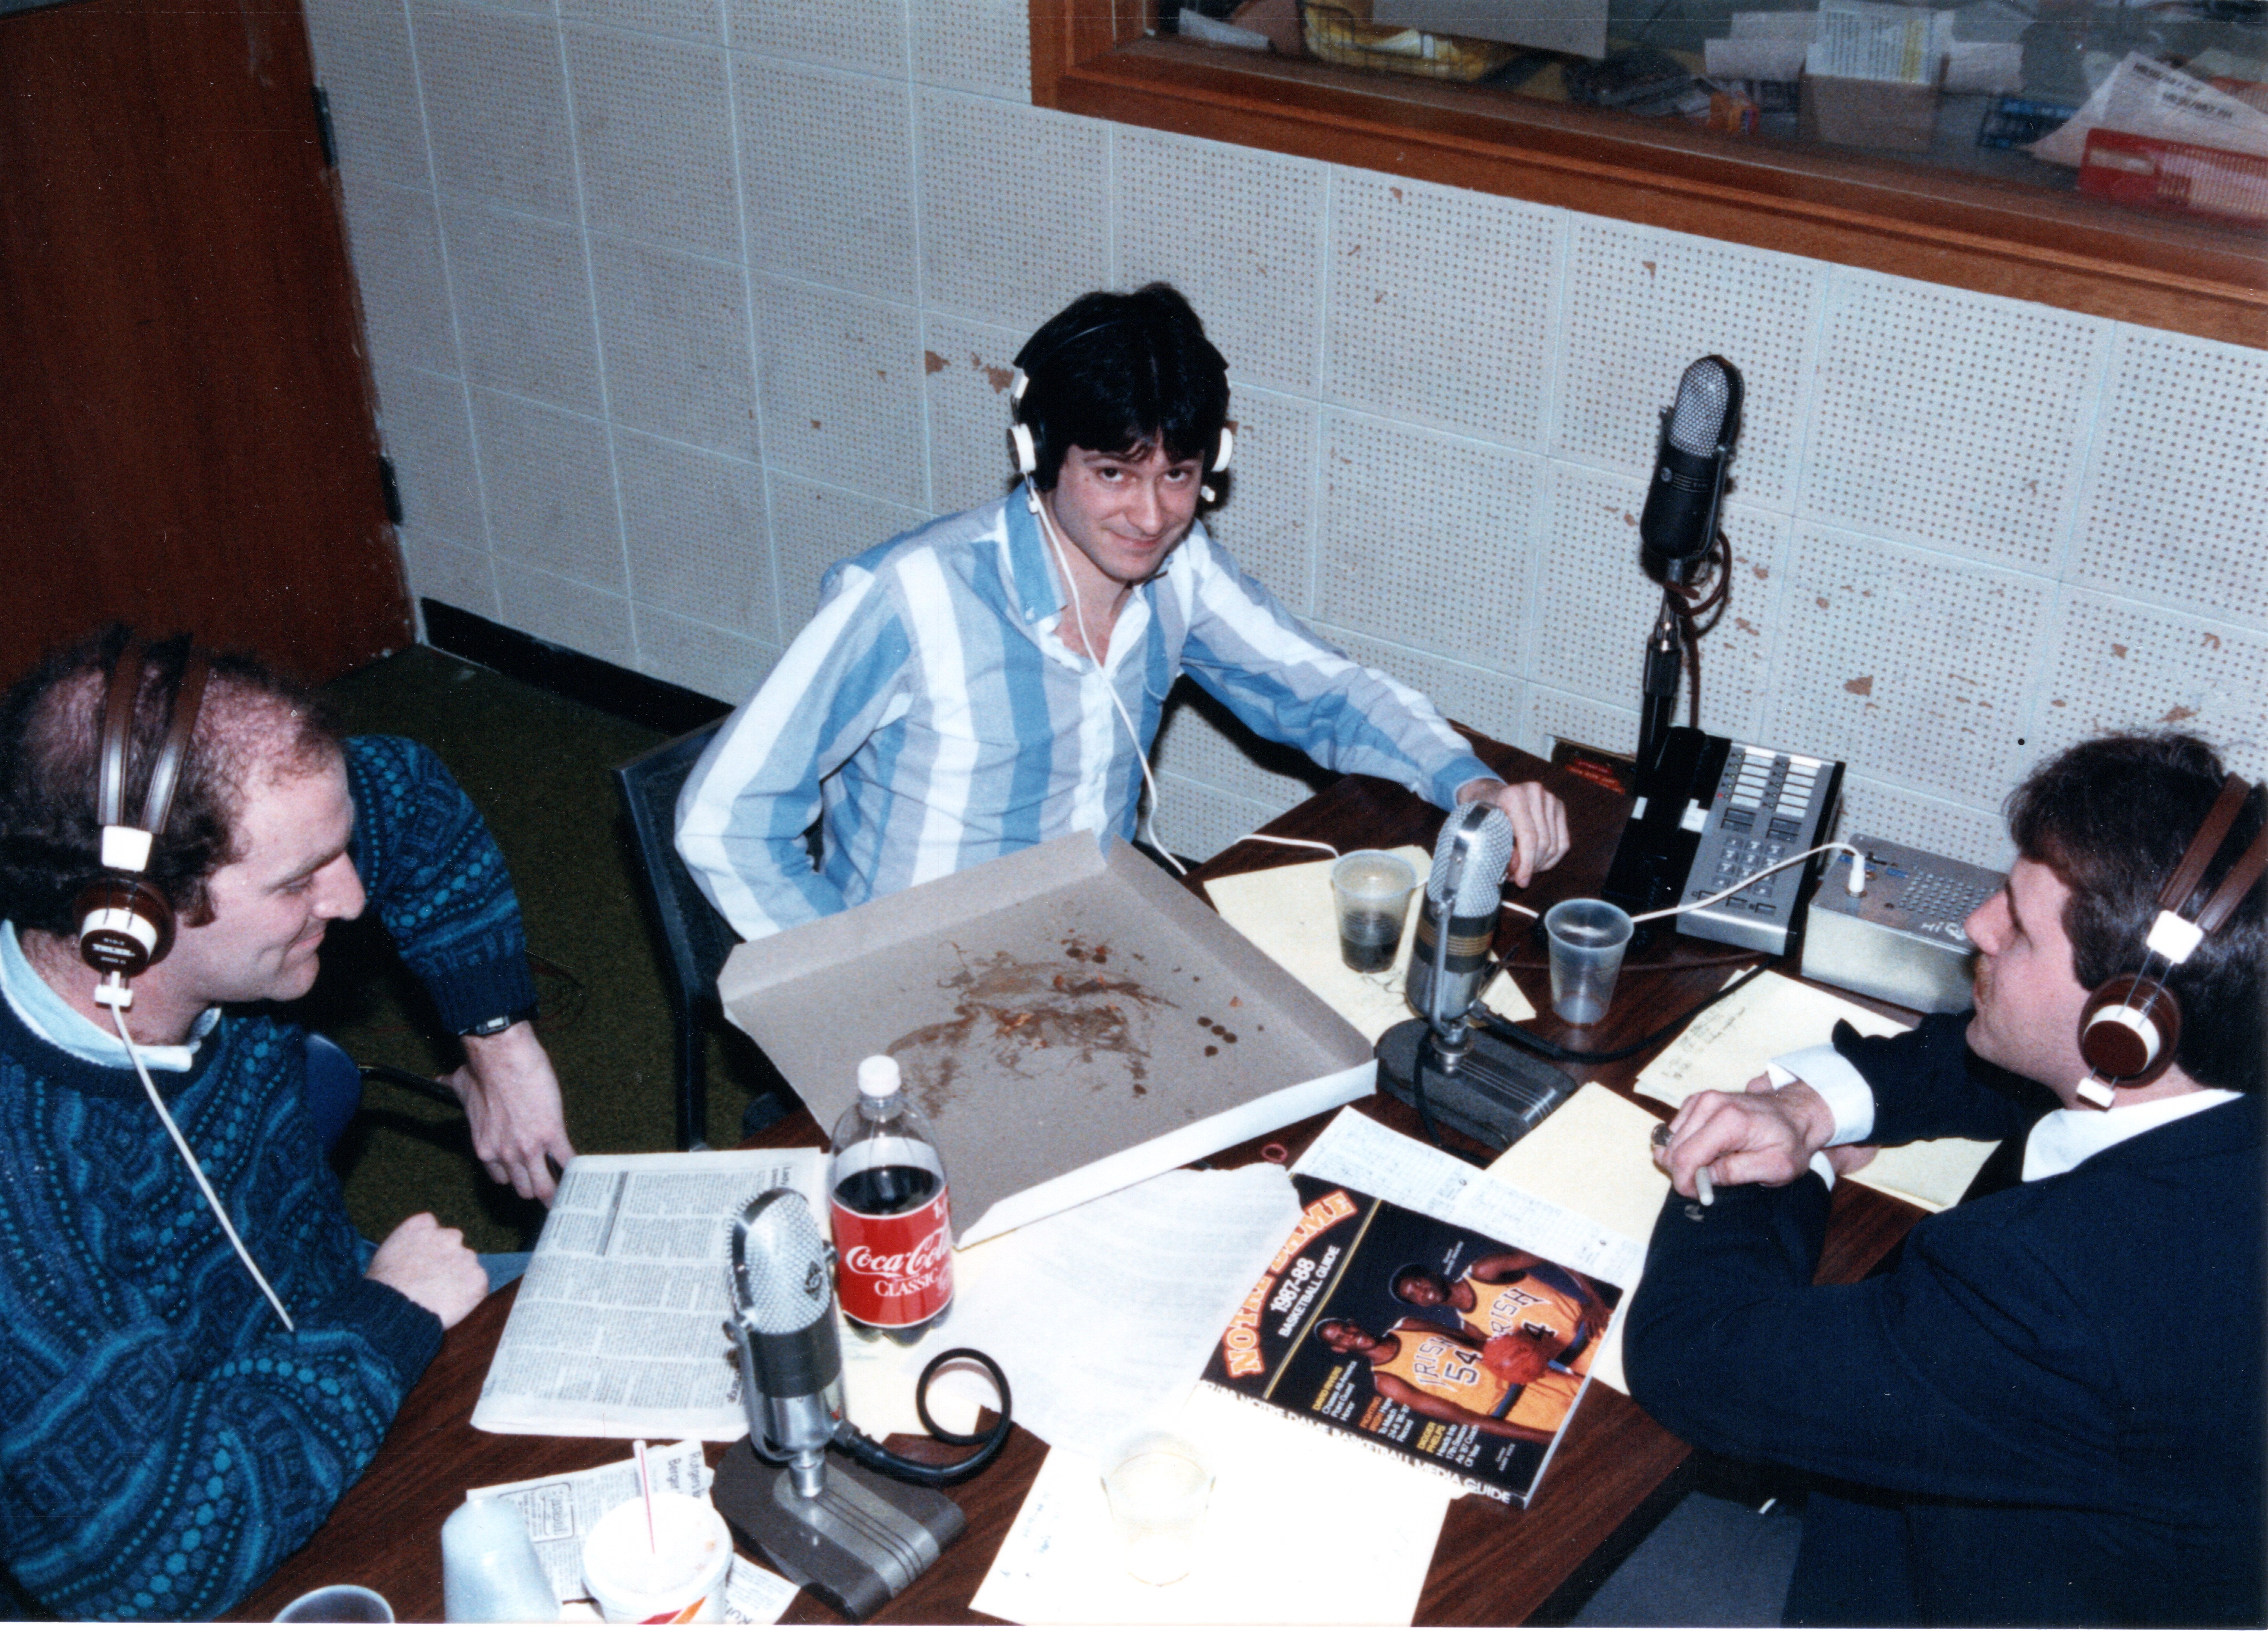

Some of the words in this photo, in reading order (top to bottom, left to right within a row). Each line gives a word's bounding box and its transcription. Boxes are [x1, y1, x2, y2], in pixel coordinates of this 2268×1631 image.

[874, 1267, 938, 1297] CLASSIC
[1270, 1257, 1316, 1312] 1987-88
[1278, 1280, 1323, 1337] BASKETBALL
[1315, 1244, 1341, 1279] GUIDE
[1488, 1287, 1552, 1338] RISH
[1414, 1336, 1459, 1392] IRISH
[1444, 1349, 1484, 1384] 54
[1312, 1389, 1329, 1411] DAVID
[1323, 1366, 1343, 1390] RIVERS
[1330, 1400, 1345, 1417] Point
[1339, 1382, 1355, 1401] Guard
[1340, 1401, 1355, 1422] Honor
[1359, 1396, 1382, 1428] FIGHTING
[1369, 1412, 1384, 1432] IRISH
[1416, 1421, 1436, 1450] DIGGER
[1426, 1424, 1446, 1453] PHELPS
[1464, 1424, 1480, 1444] Coach
[1288, 1412, 1330, 1435] DAME
[1332, 1428, 1411, 1465] BASKETBALL
[1413, 1458, 1463, 1487] MEDIA
[1464, 1477, 1511, 1504] GUIDE
